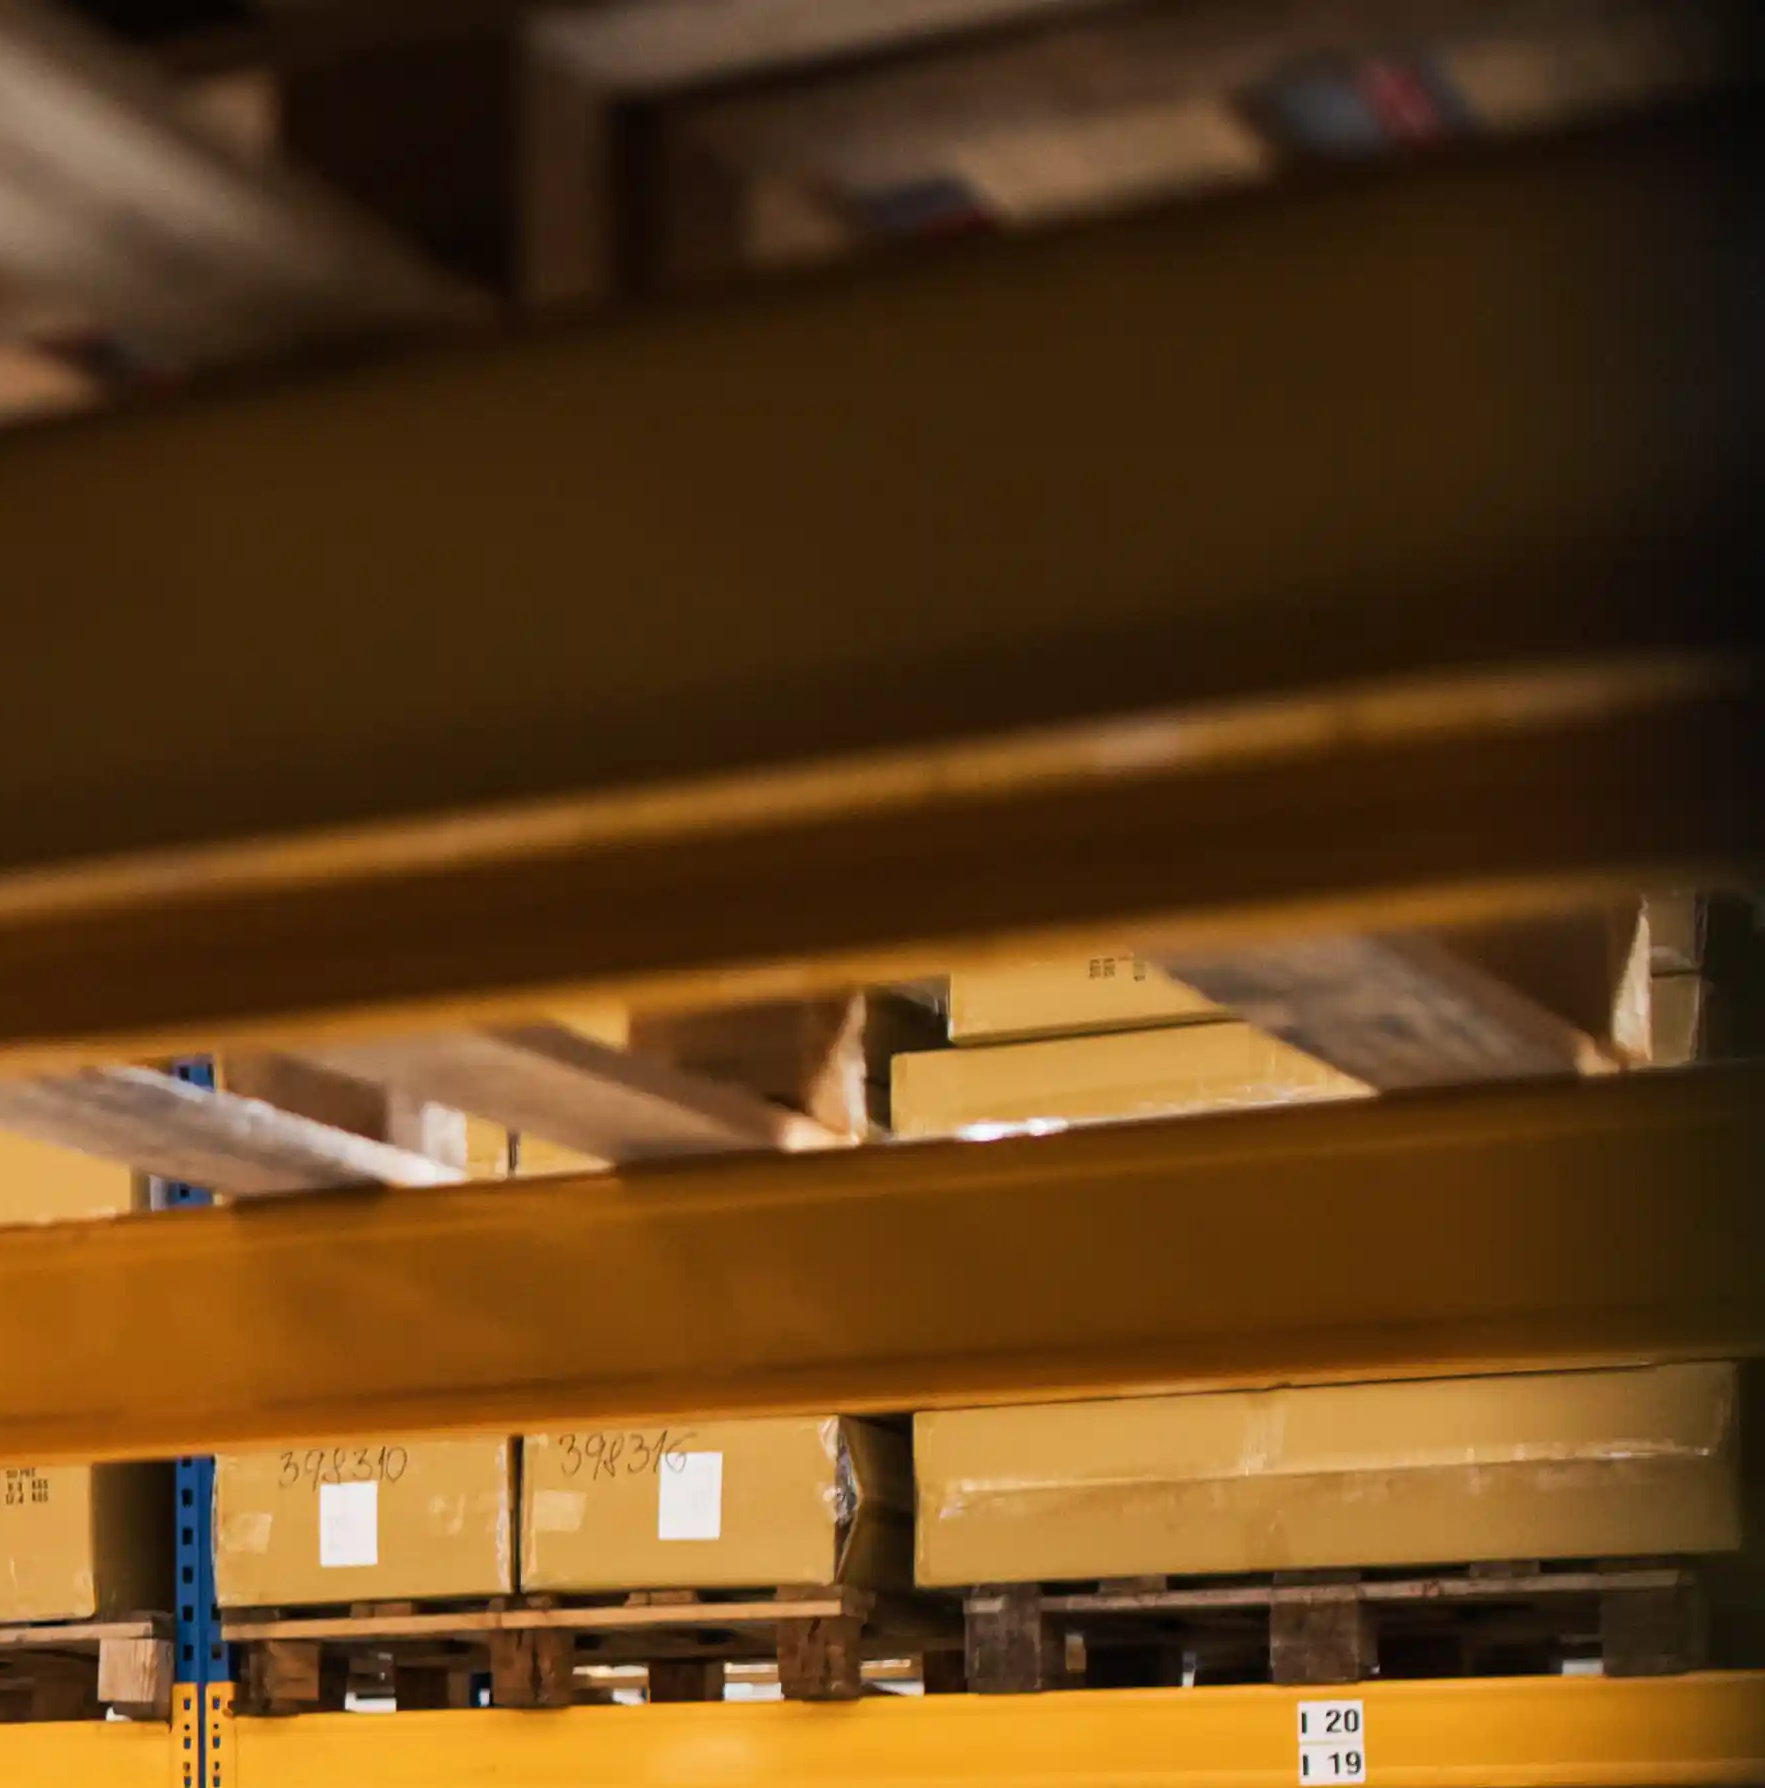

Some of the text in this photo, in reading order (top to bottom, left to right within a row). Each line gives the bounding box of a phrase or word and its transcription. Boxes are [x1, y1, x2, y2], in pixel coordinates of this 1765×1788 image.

[278, 1445, 408, 1491] 398310
[559, 1430, 695, 1480] 398316
[1325, 1708, 1359, 1733] 20
[1328, 1751, 1362, 1775] 19
